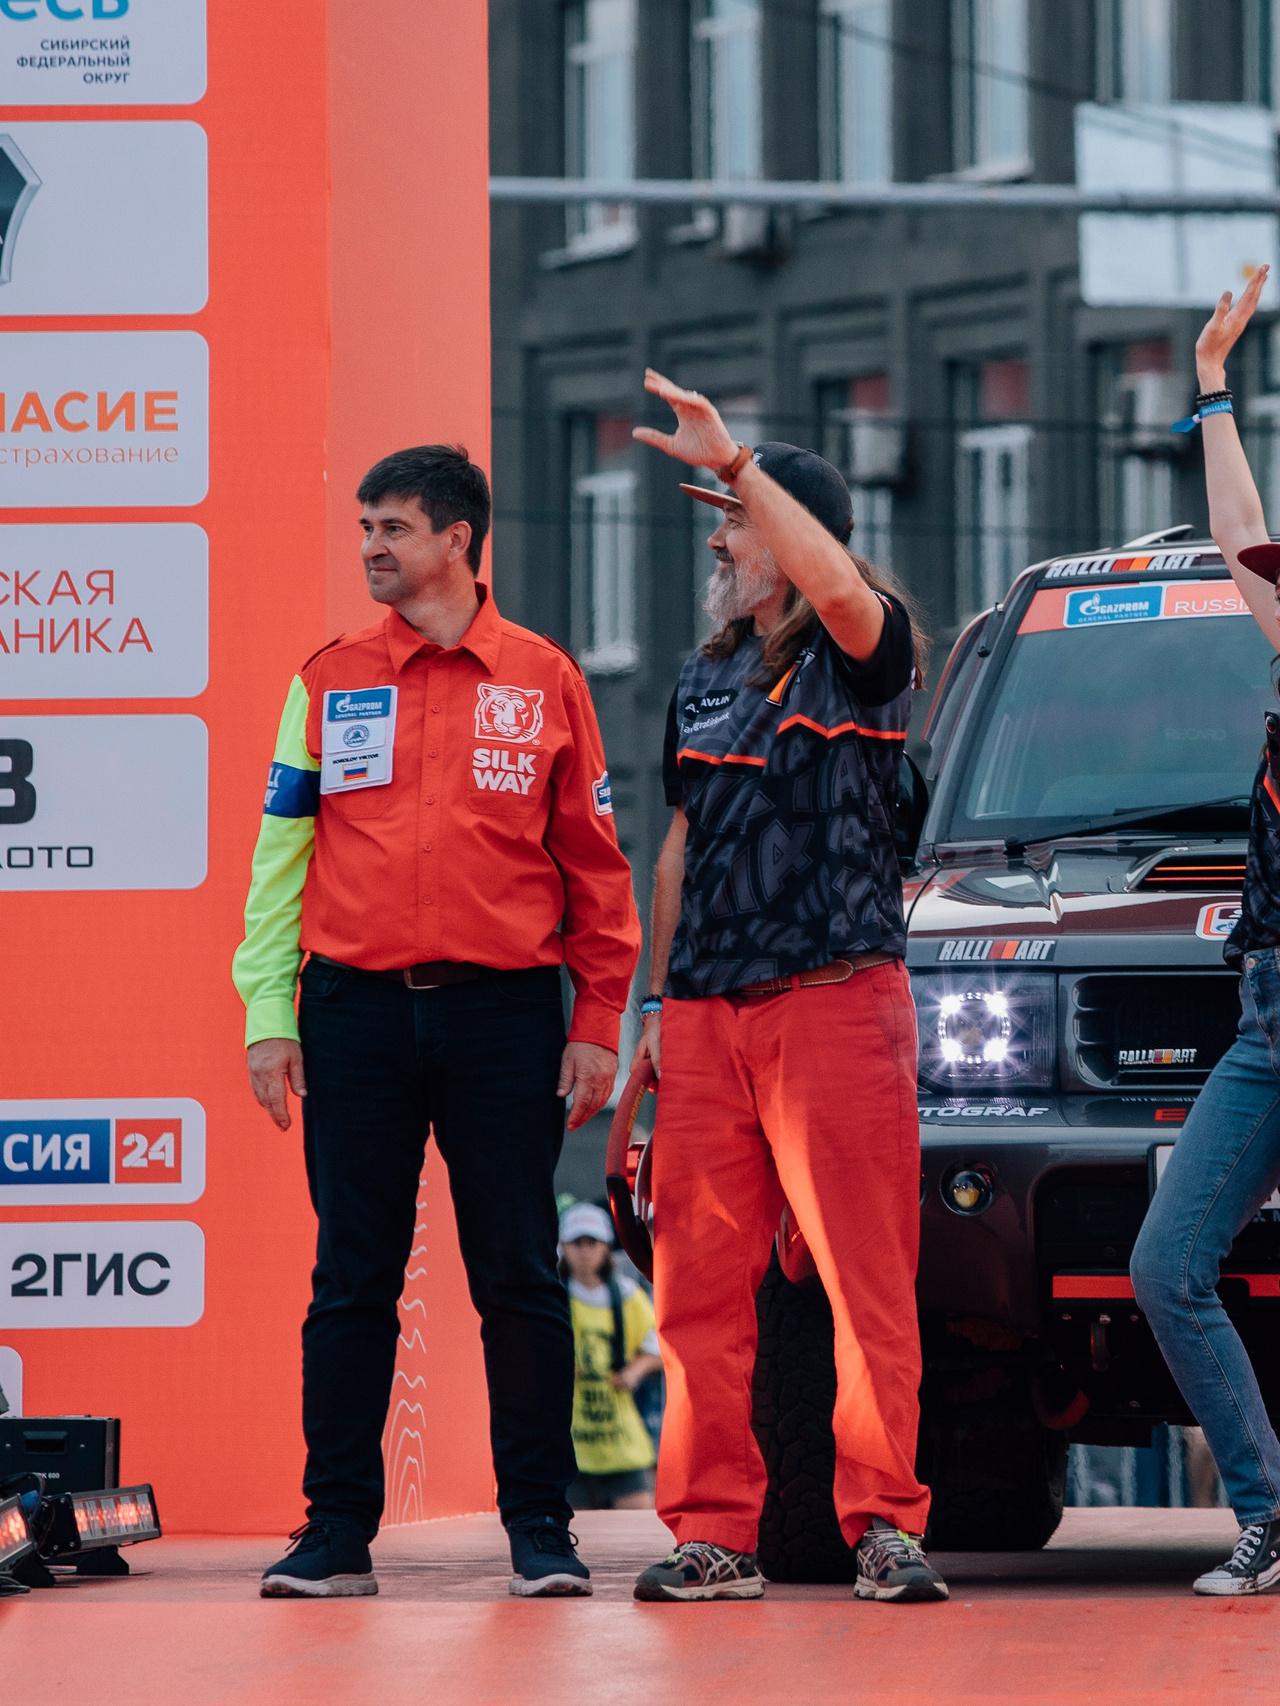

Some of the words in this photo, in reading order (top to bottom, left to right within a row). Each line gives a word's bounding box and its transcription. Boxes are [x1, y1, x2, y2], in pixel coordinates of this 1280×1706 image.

[40, 36, 130, 51] СИБИРСКИЙ
[16, 53, 130, 69] ФЕДЕРАЛЬНЫЙ
[83, 72, 130, 84] ОКРУГ
[0, 390, 179, 433] АСИЕ
[1044, 559, 1117, 579] RALLI
[1146, 554, 1199, 571] ART
[1100, 601, 1149, 614] GAZPROM
[1174, 598, 1249, 613] RUSSI
[472, 747, 537, 775] SILK
[472, 768, 537, 796] WAY
[0, 846, 94, 869] ОТО
[938, 940, 993, 961] RALLI
[1014, 940, 1056, 960] ART
[3, 1133, 90, 1172] СИЯ
[121, 1132, 175, 1168] 24
[11, 1252, 171, 1296] 2ГИС
